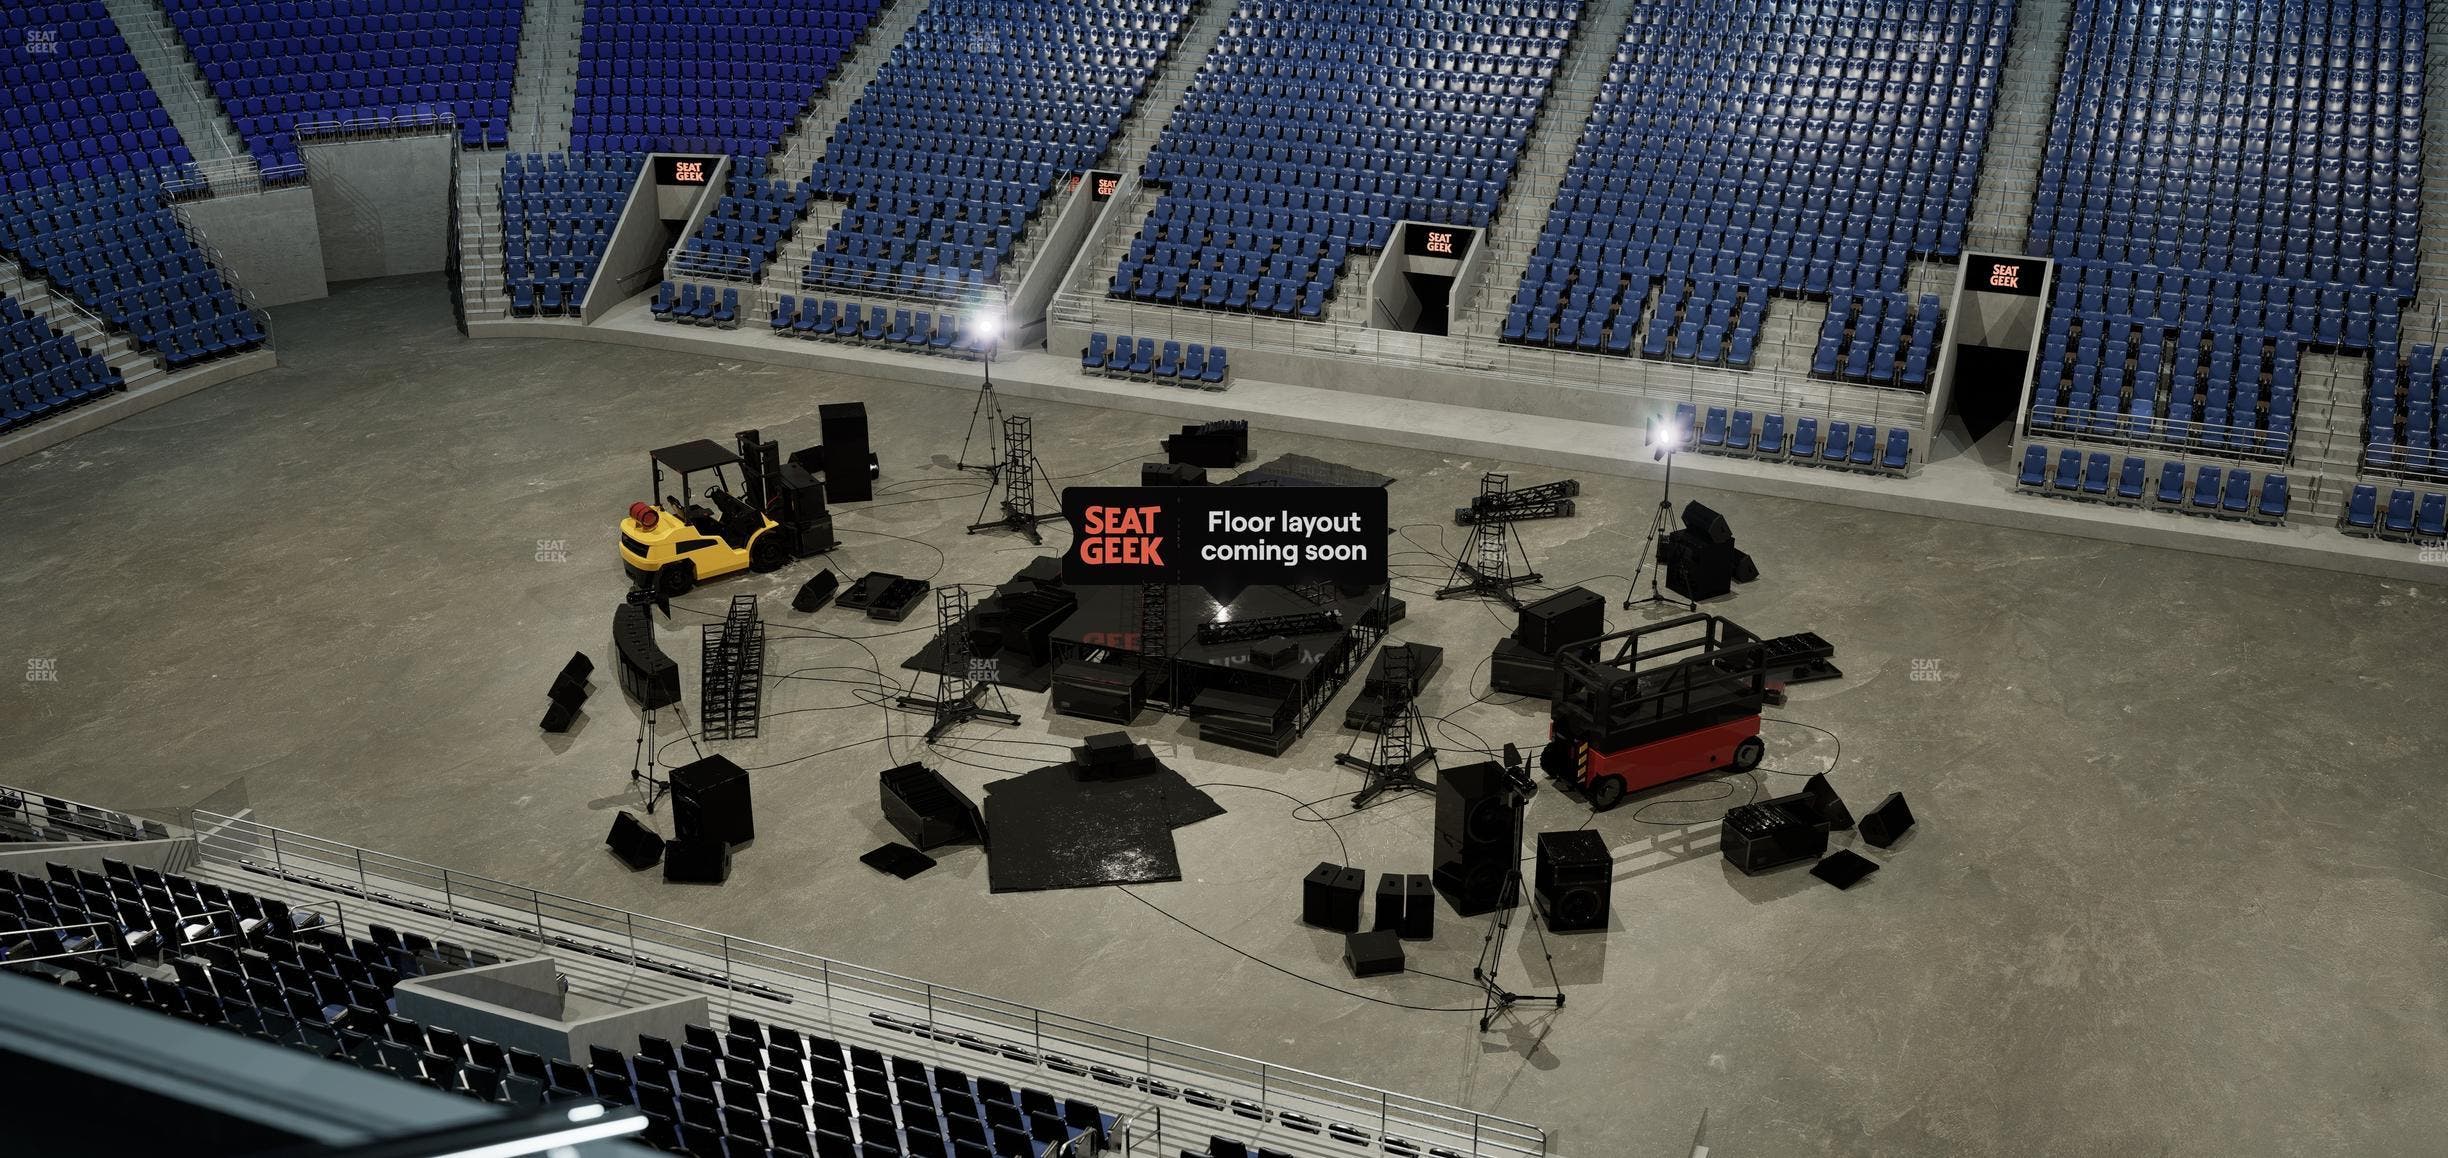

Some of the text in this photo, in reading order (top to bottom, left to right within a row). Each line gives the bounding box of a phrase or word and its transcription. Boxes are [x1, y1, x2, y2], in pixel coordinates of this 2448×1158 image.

[676, 162, 702, 172] SEAT
[676, 172, 704, 181] GEEK
[1099, 179, 1117, 188] SEAT
[1429, 232, 1452, 243] SEAT
[1427, 242, 1452, 253] GEEK
[1993, 264, 2019, 276] SEAT
[1990, 275, 2019, 288] GEEK
